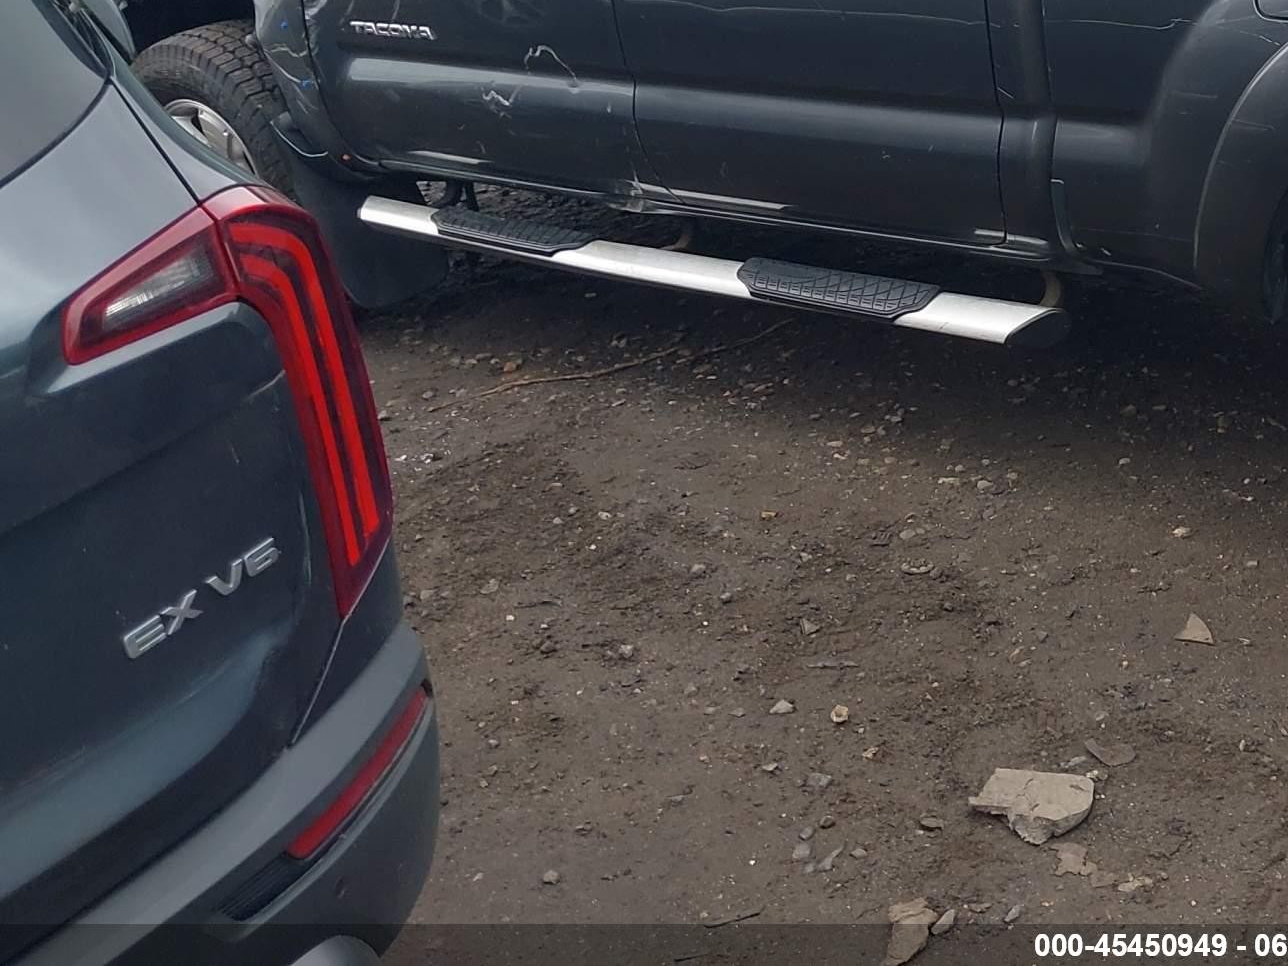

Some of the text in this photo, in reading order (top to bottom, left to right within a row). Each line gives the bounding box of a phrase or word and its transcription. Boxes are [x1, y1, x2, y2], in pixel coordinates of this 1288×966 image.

[349, 20, 438, 41] TACOMA
[123, 537, 282, 660] EX V6
